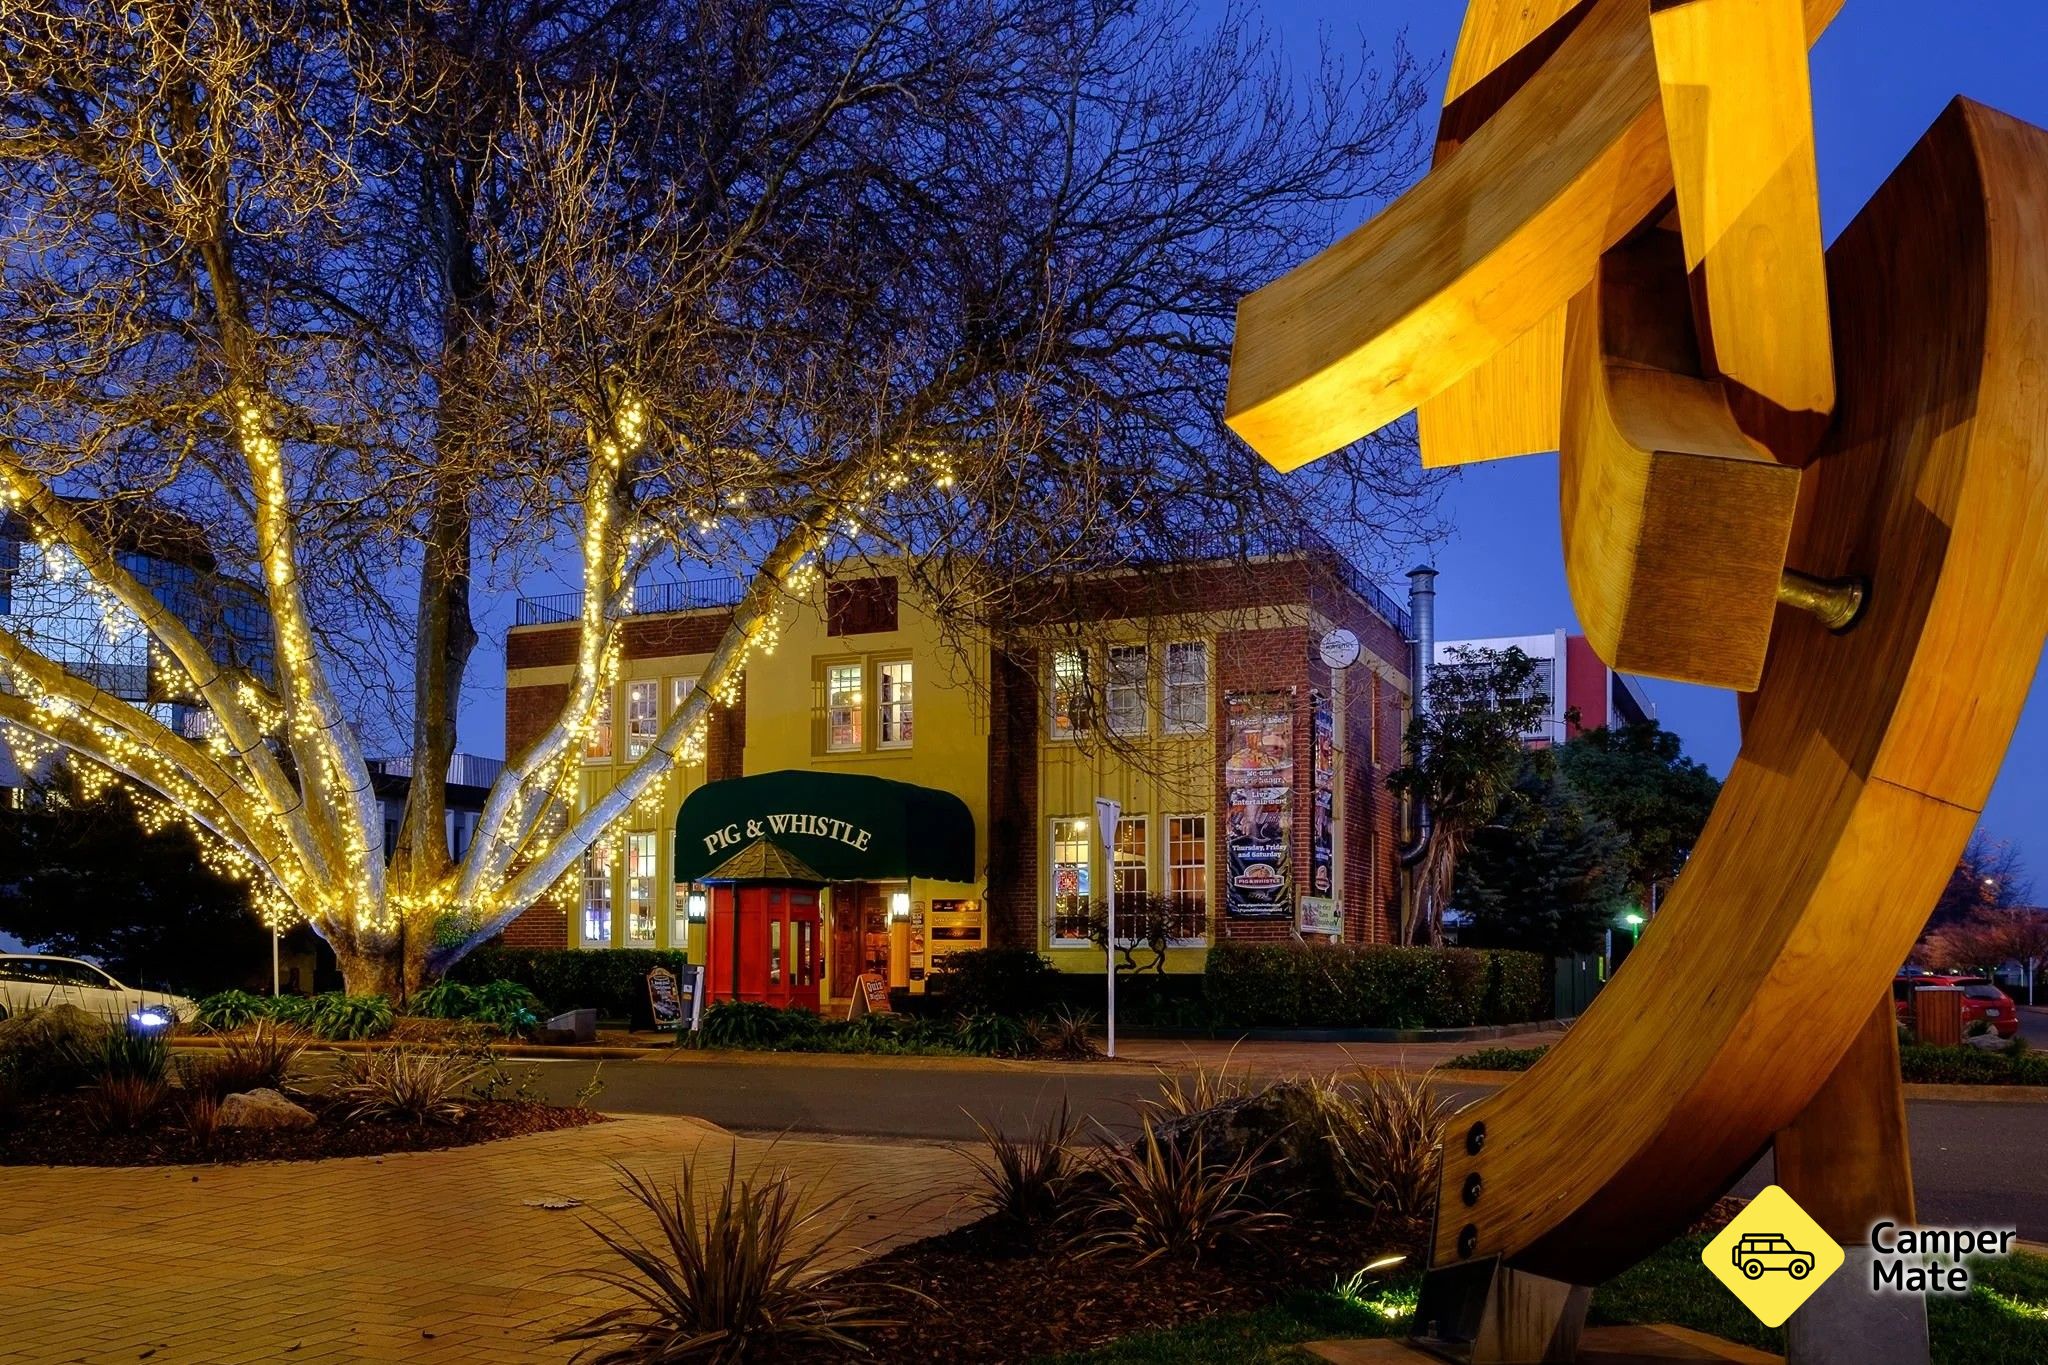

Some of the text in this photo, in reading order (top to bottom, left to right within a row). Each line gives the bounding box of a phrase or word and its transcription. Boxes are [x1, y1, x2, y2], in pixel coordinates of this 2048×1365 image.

[703, 814, 872, 856] PIG & WHISTLE
[867, 981, 883, 992] Quiz
